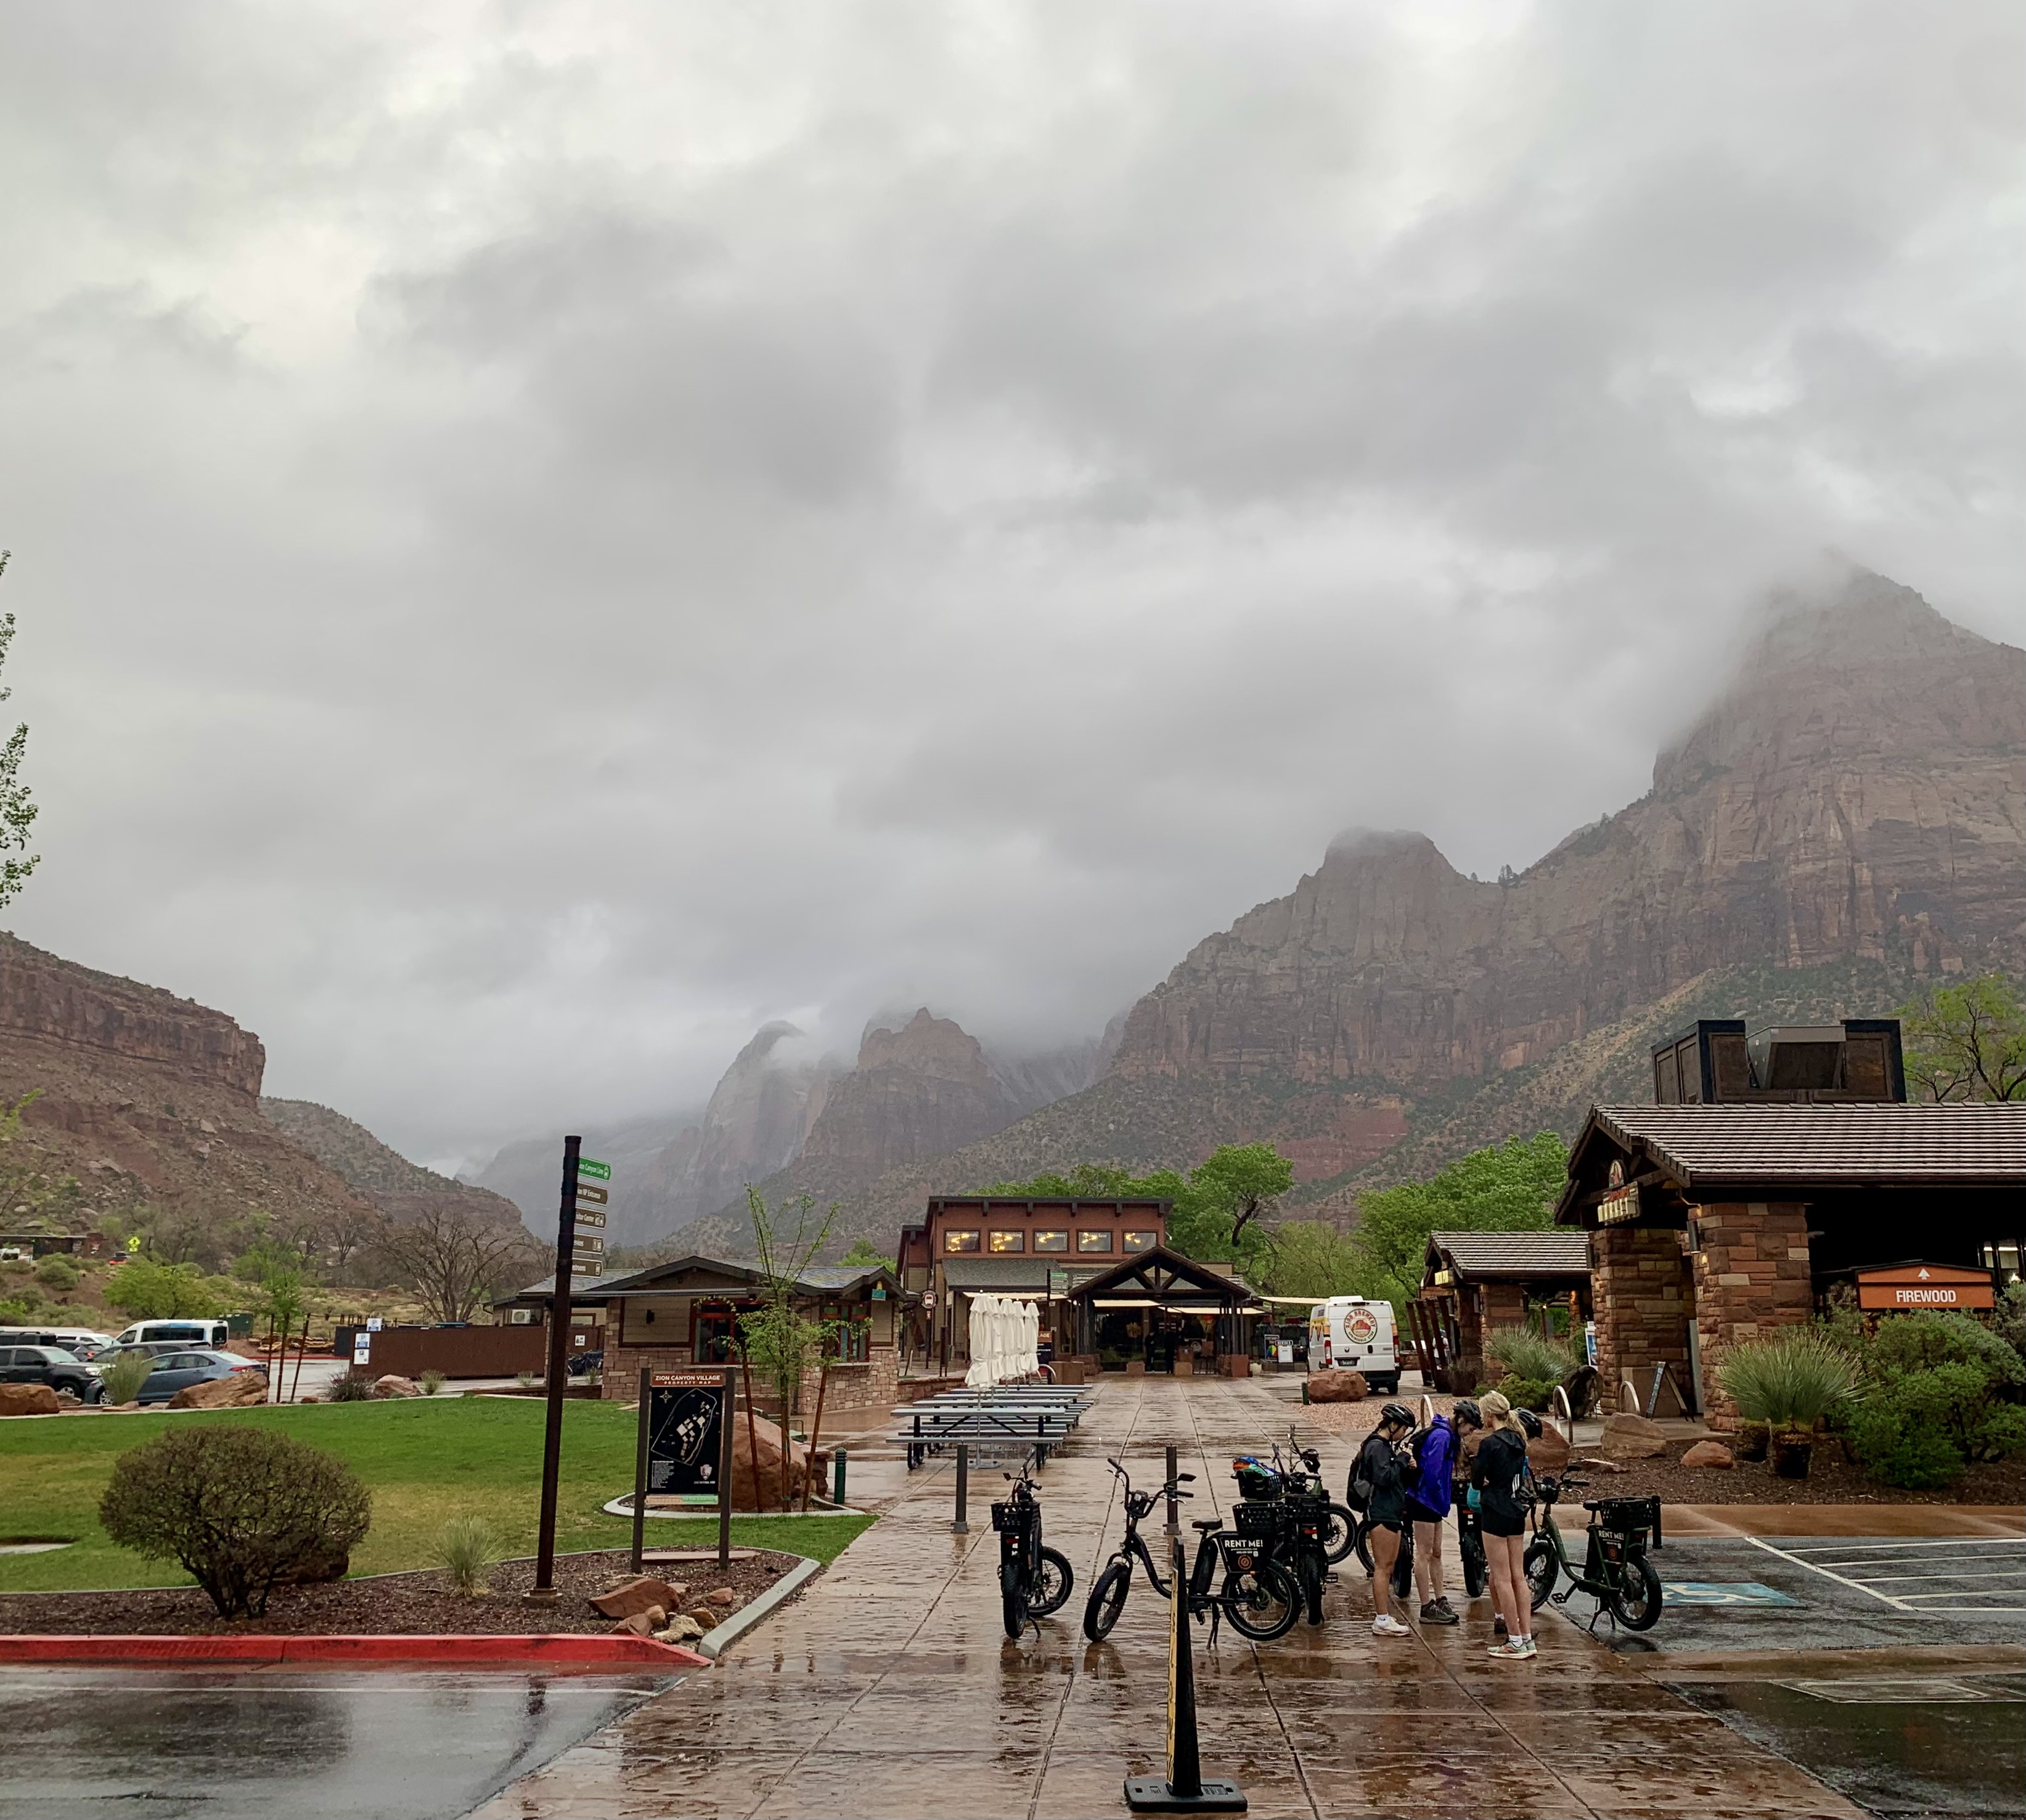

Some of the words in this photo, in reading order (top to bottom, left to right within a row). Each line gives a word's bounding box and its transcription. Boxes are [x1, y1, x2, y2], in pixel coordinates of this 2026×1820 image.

[585, 1164, 597, 1174] Canyon
[587, 1190, 601, 1199] Entrance
[584, 1214, 595, 1222] Center
[1896, 1290, 1956, 1303] FIREWOOD
[1598, 1530, 1612, 1538] RENT
[1614, 1532, 1624, 1540] ME!
[1225, 1540, 1247, 1548] RENT
[1248, 1540, 1264, 1548] ME!
